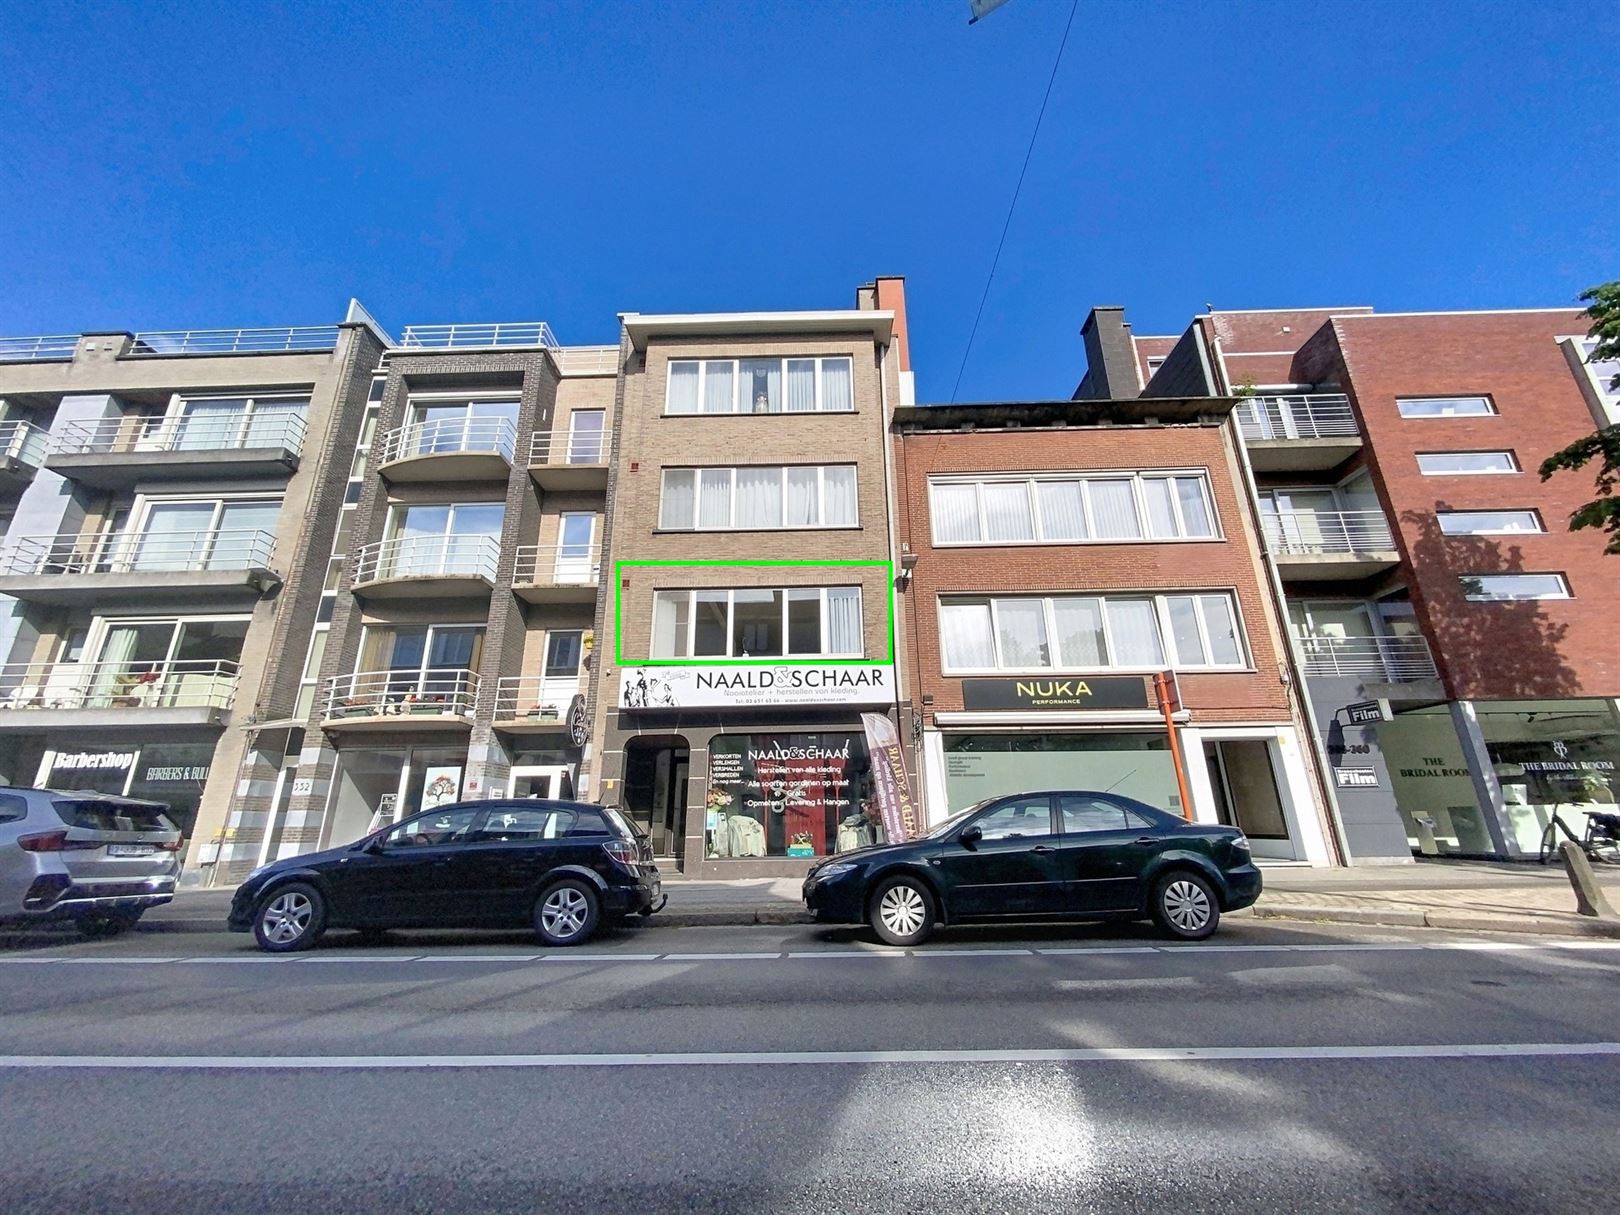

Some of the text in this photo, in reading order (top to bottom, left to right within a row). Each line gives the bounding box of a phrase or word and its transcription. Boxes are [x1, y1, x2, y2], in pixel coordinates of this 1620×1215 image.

[776, 687, 813, 696] herstellen
[830, 687, 858, 696] kleding
[1016, 681, 1093, 697] NUKA
[1352, 709, 1380, 722] Film
[53, 752, 134, 769] Barbershop
[1422, 757, 1446, 766] THE
[817, 766, 841, 774] kleding
[1518, 761, 1616, 771] THE BRIDAL ROOM
[146, 767, 184, 781] BARBERS
[183, 767, 191, 780] &
[1400, 768, 1442, 777] BRIDAL
[1338, 773, 1376, 784] Film
[823, 798, 850, 806] Hangen
